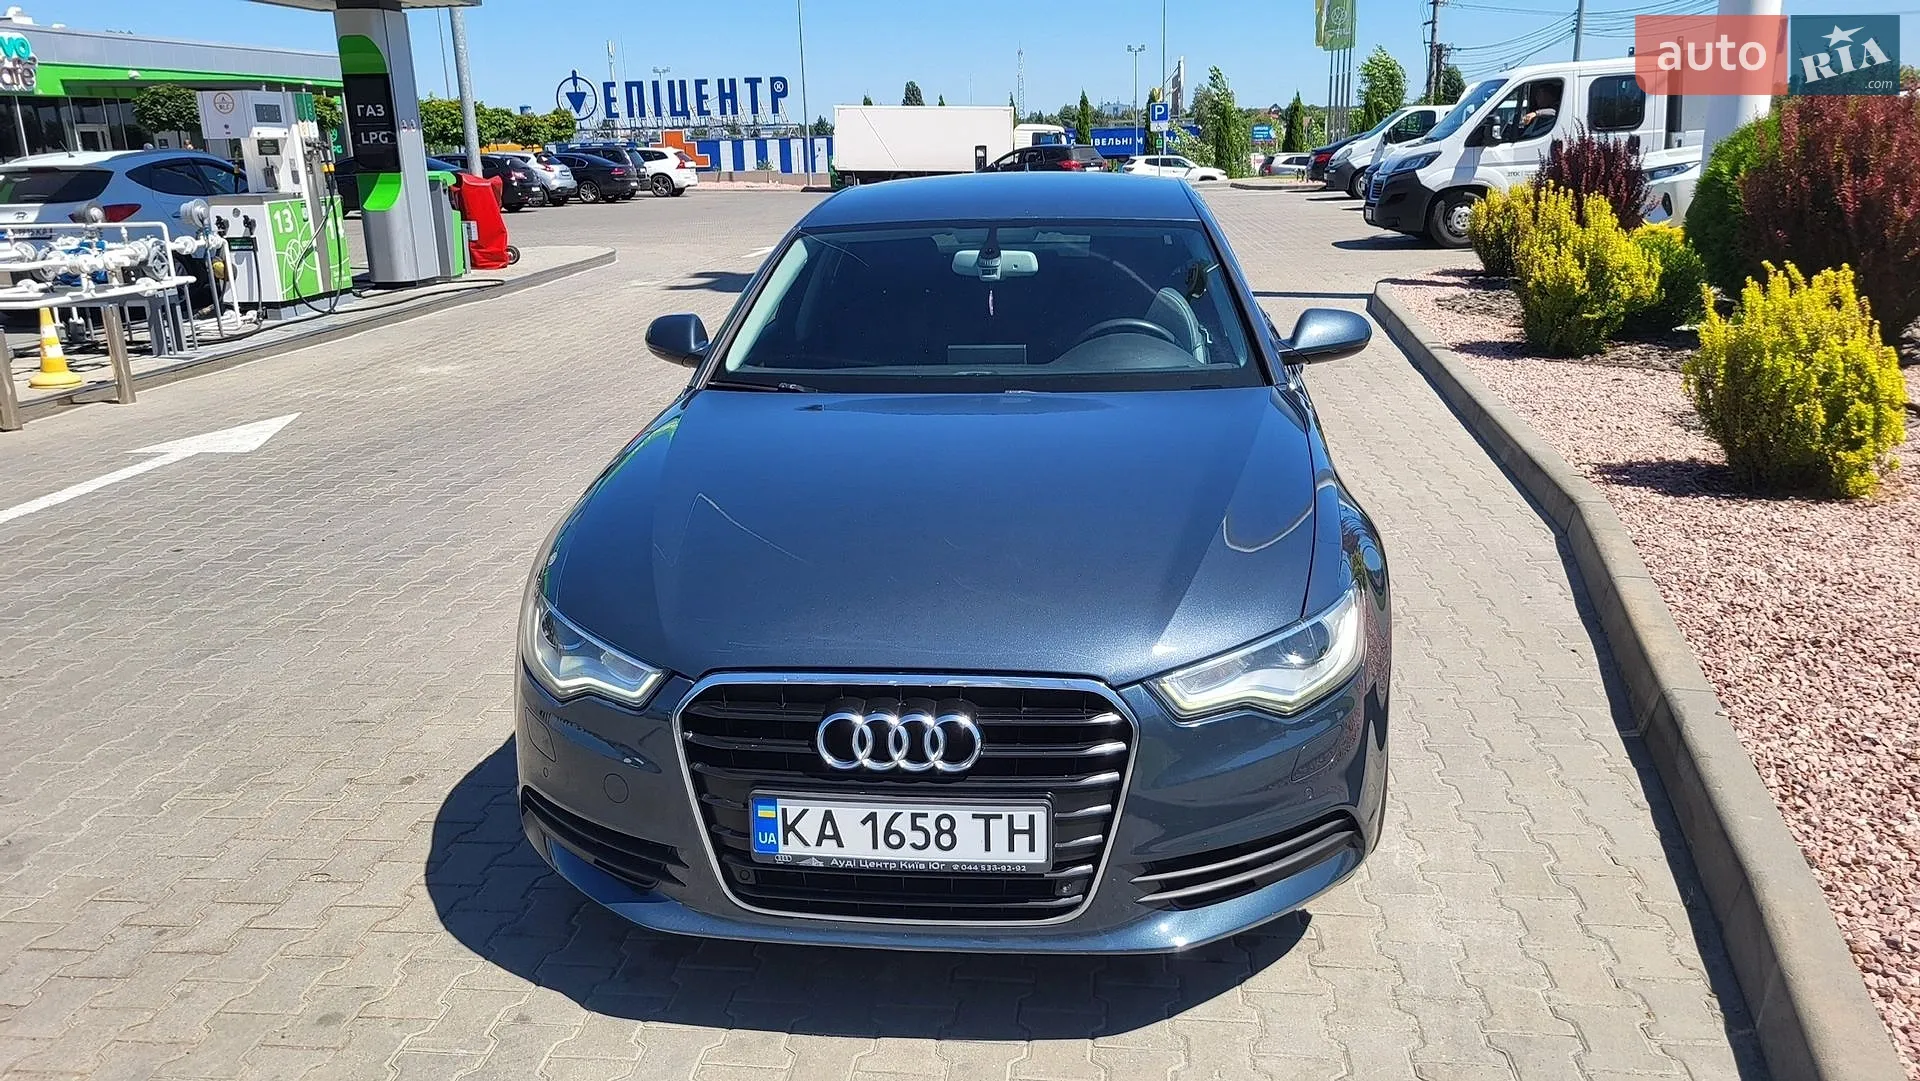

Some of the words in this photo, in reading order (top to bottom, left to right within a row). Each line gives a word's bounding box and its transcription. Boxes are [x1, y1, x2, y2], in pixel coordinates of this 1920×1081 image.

[602, 76, 788, 120] ЕПІЦЕНТР
[356, 104, 385, 117] ГАЗ
[1154, 105, 1165, 120] P
[361, 131, 389, 144] LPG
[273, 207, 295, 234] 13
[780, 807, 845, 848] KA
[860, 811, 957, 850] 1658
[971, 813, 1036, 852] TH
[758, 832, 777, 845] UA
[830, 858, 856, 868] Ауді
[860, 860, 896, 871] Центр
[900, 860, 927, 870] Київ
[929, 861, 946, 871] Юг
[961, 863, 979, 871] 044
